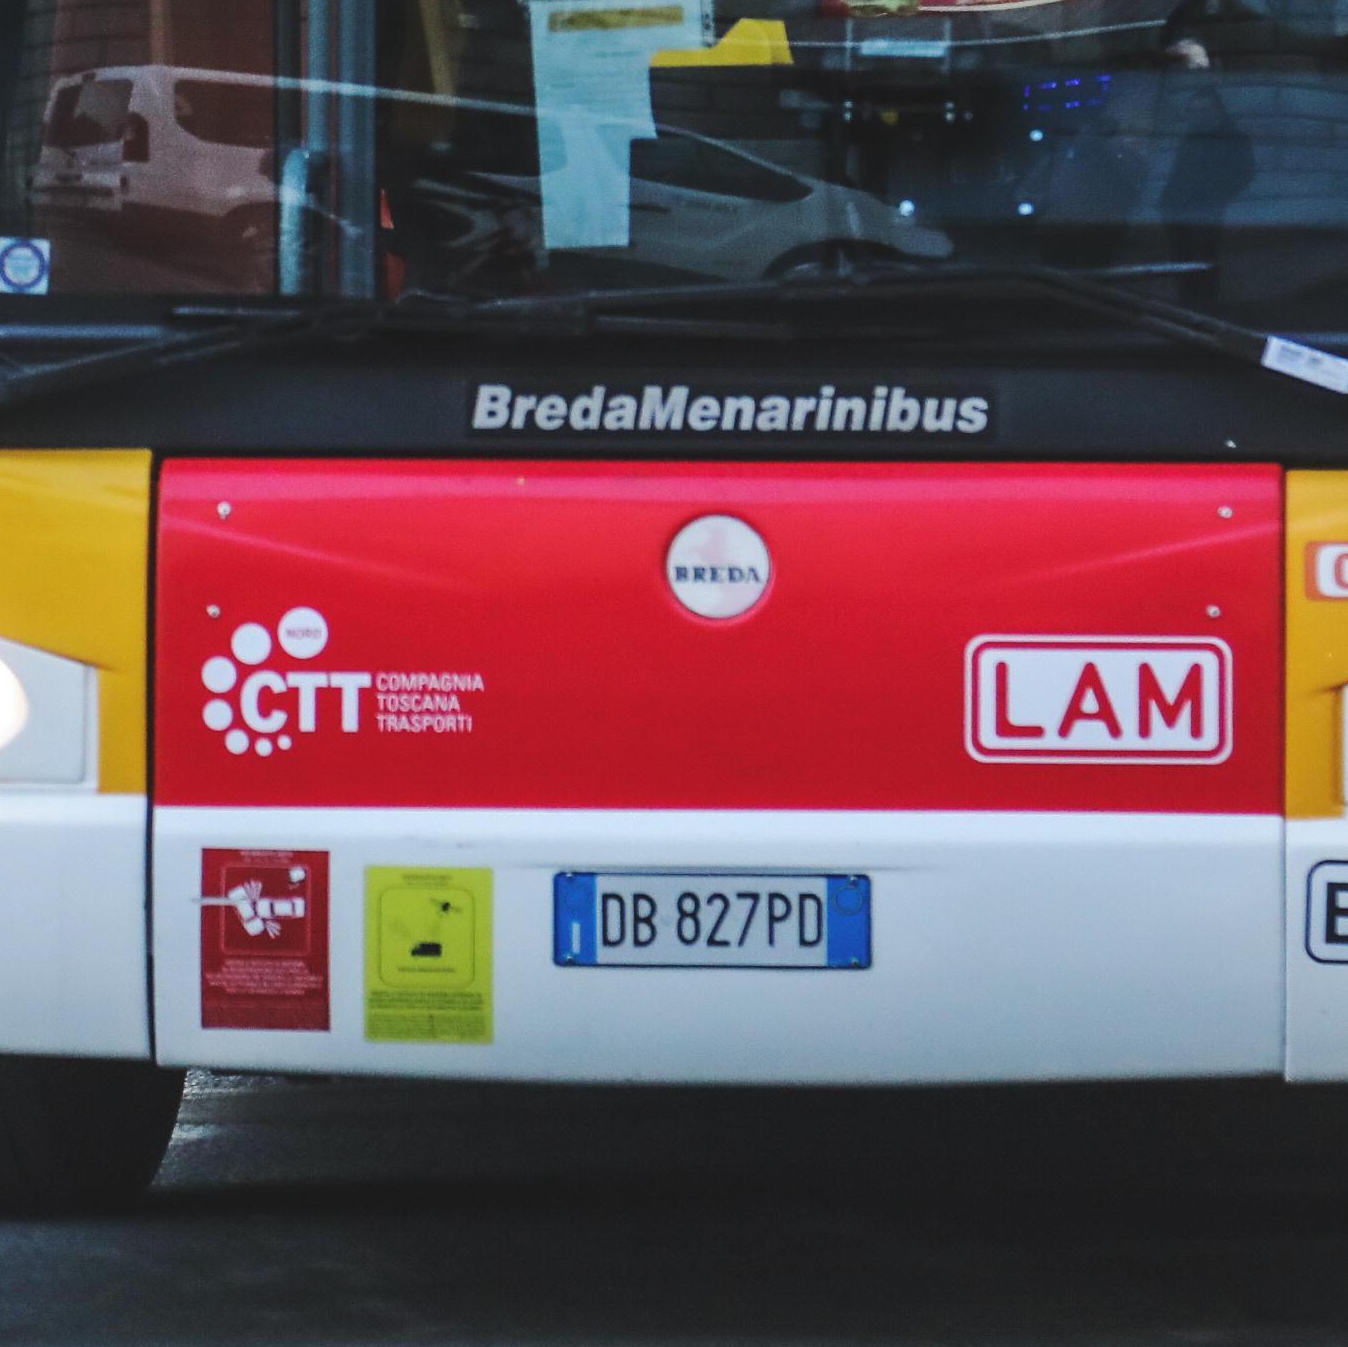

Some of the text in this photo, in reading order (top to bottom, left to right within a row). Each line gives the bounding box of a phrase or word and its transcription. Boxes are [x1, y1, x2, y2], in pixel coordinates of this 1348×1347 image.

[471, 384, 989, 434] BredaMenarinibus
[675, 566, 761, 583] BREDA
[376, 672, 485, 692] COMPAGNIA
[240, 670, 372, 733] CTT
[376, 693, 461, 712] TOSCANA
[995, 661, 1204, 739] LAM
[376, 714, 473, 733] TRASPORTI
[602, 892, 657, 948] DB
[676, 891, 824, 948] 827PD
